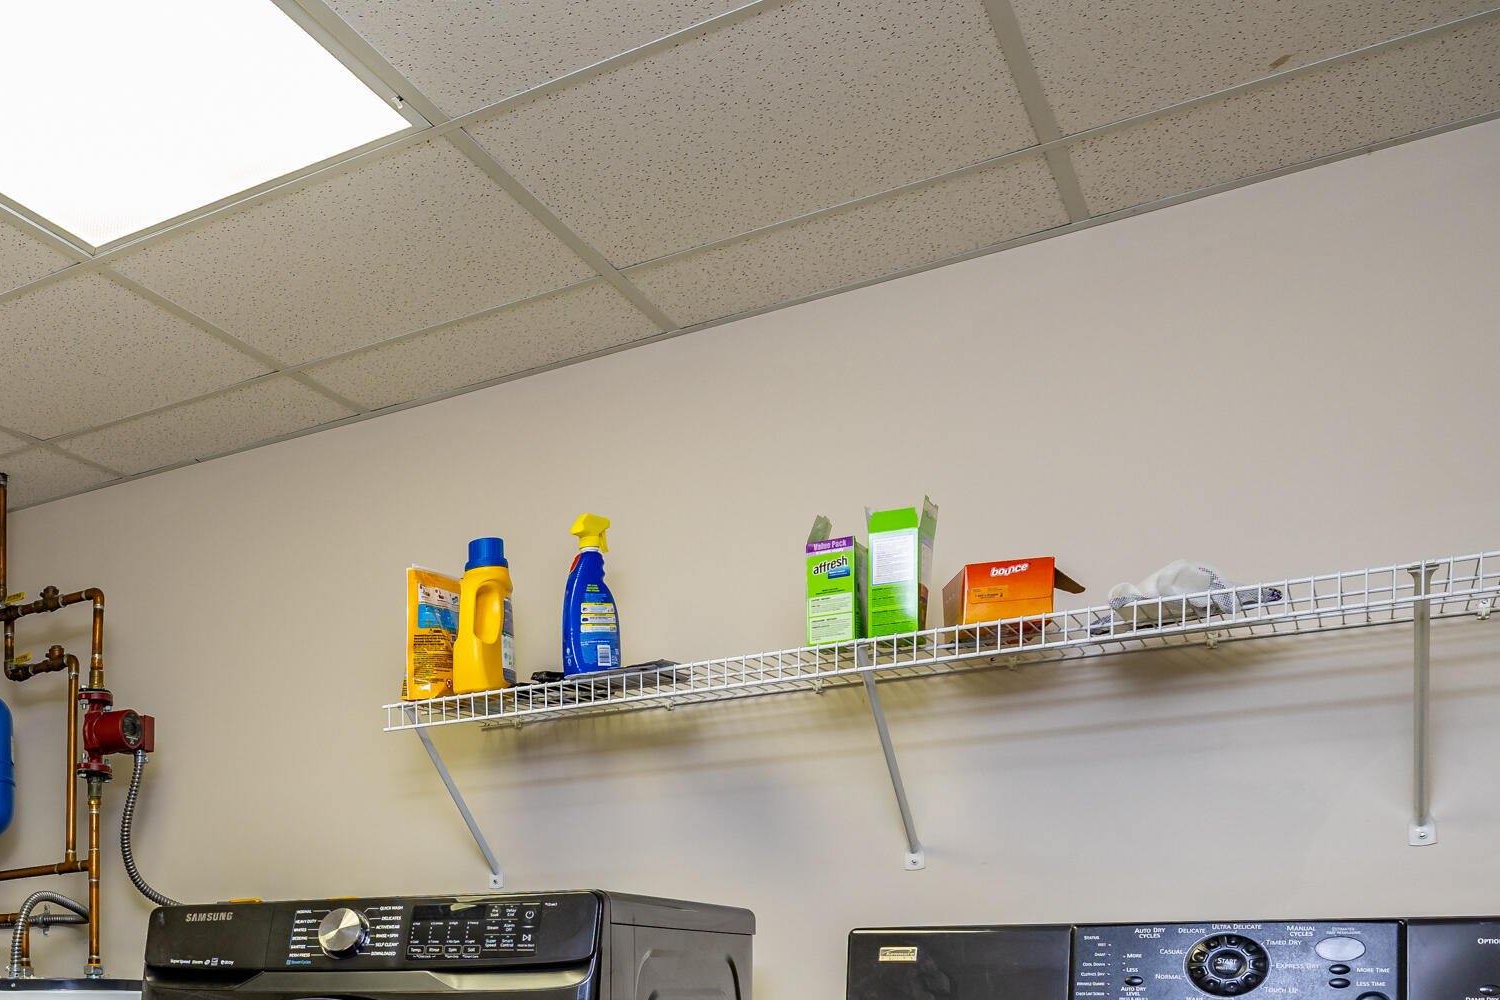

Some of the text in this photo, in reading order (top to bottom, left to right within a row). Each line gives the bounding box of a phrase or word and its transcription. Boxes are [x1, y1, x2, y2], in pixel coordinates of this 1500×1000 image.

[831, 539, 847, 548] Pack
[812, 555, 848, 575] affresh
[990, 563, 1029, 577] bounce
[185, 911, 234, 922] SAMSUNG
[1217, 957, 1237, 965] START
